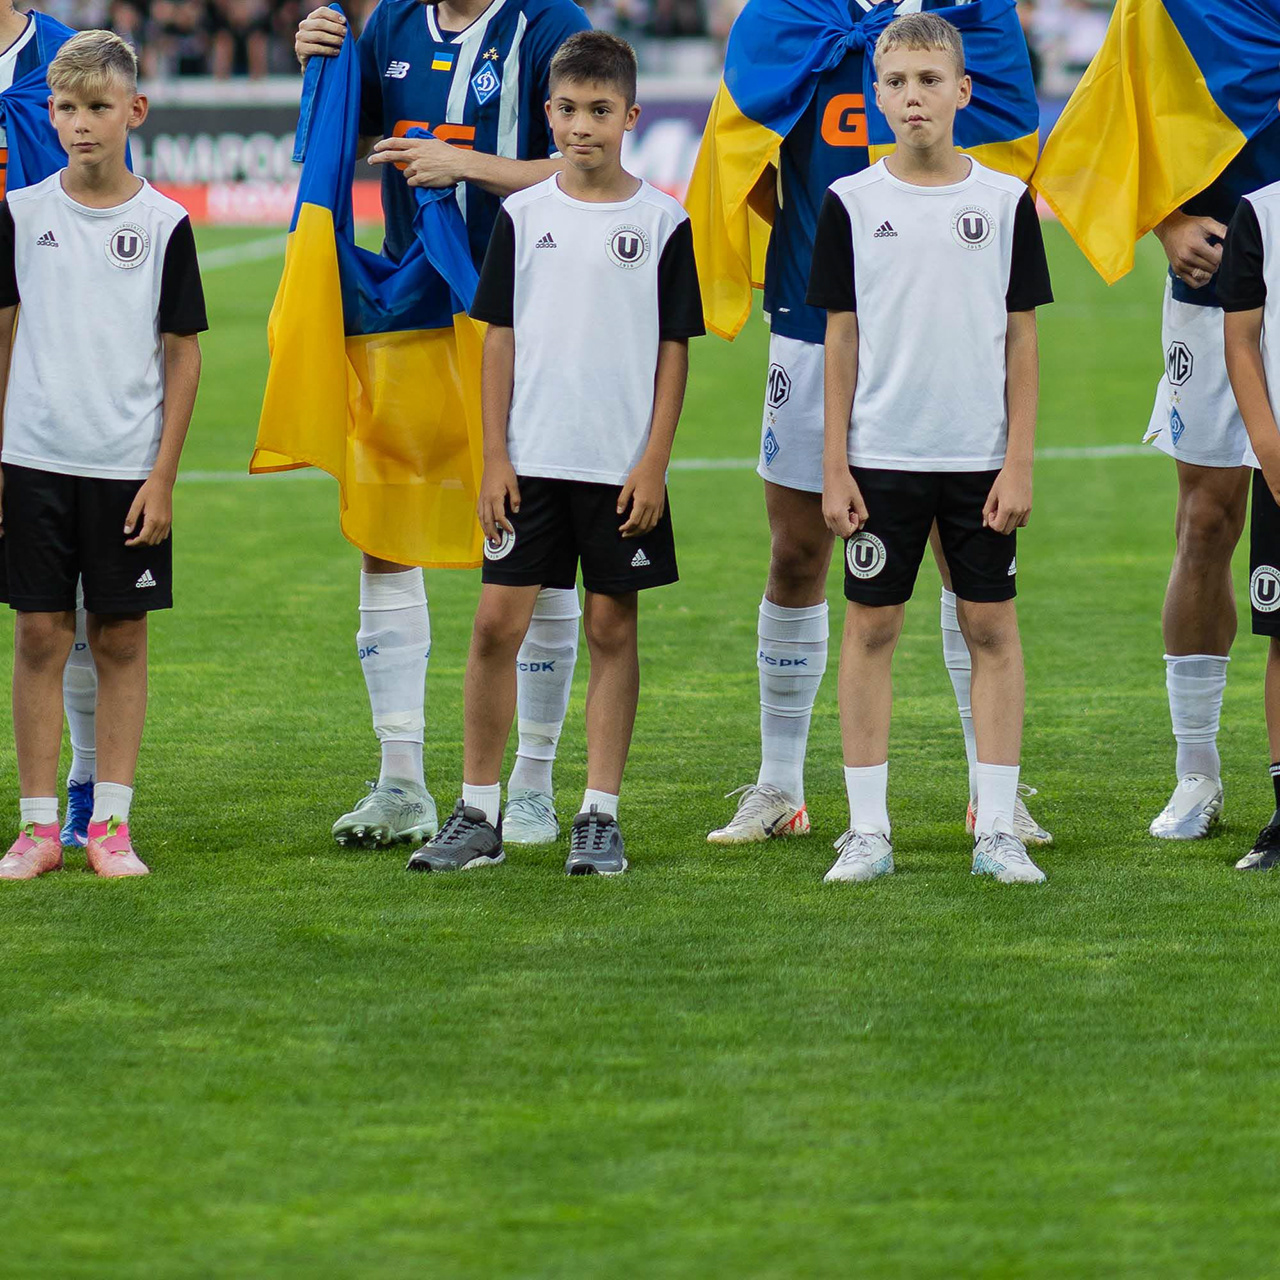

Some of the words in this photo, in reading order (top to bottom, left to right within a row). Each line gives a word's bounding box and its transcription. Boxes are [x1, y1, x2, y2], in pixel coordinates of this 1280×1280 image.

[963, 218, 983, 240] U
[117, 235, 138, 258] U
[618, 236, 639, 259] U
[855, 544, 874, 567] U
[1258, 578, 1276, 602] U
